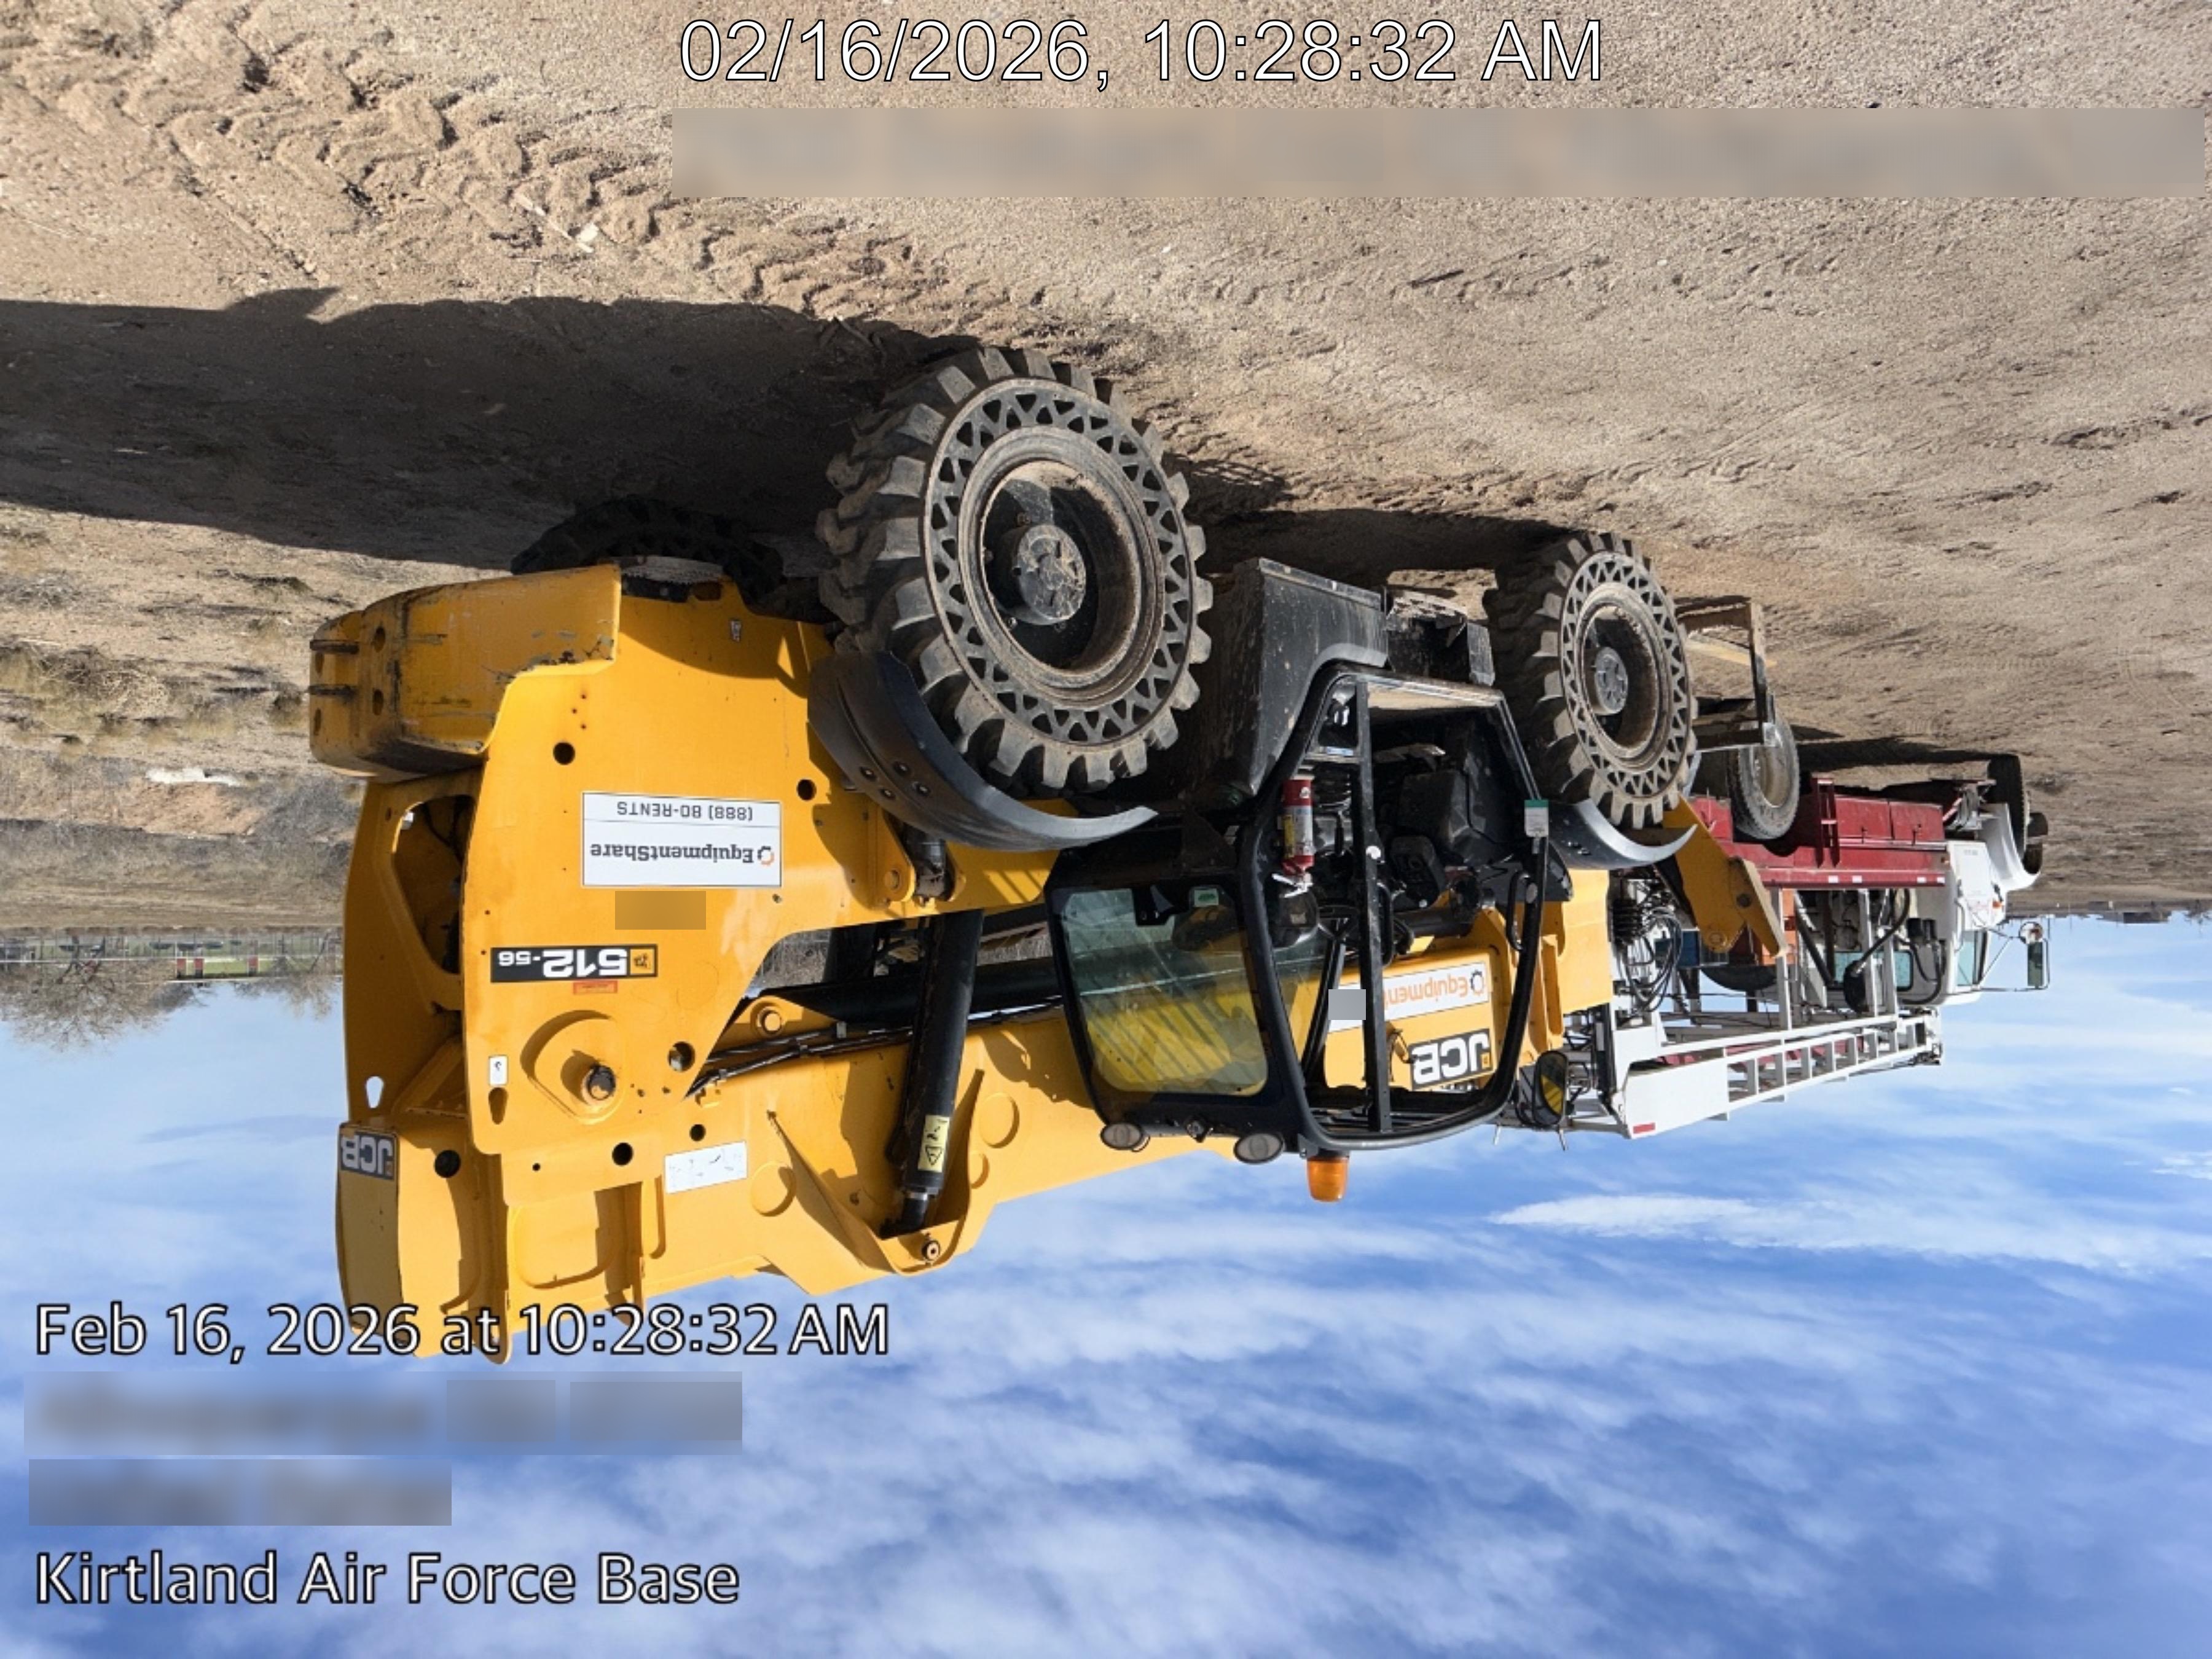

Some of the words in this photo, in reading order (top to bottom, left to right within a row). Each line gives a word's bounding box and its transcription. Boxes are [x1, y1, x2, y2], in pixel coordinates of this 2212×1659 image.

[617, 802, 701, 818] 80-RENTS
[709, 805, 753, 822] (888)
[590, 844, 753, 863] EquipmentShare
[498, 949, 628, 978] 512-56
[1412, 1032, 1490, 1084] JCB
[341, 1134, 393, 1175] JCB
